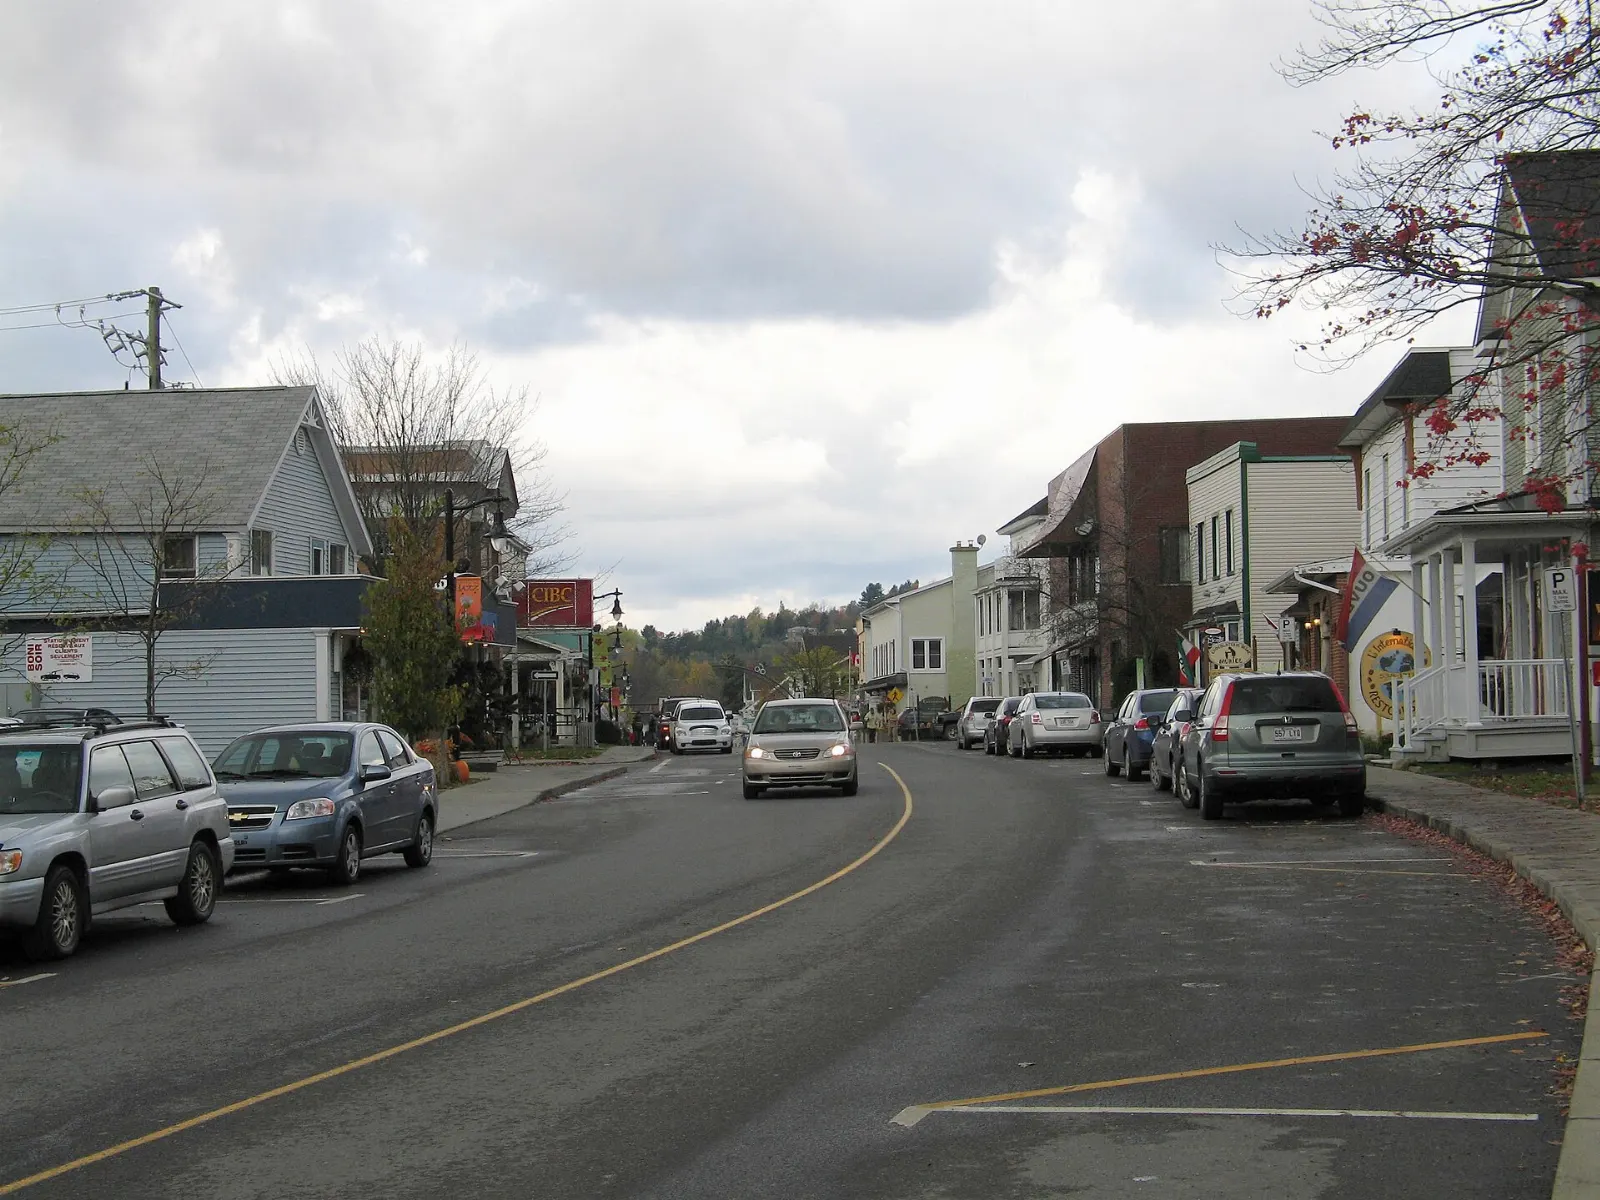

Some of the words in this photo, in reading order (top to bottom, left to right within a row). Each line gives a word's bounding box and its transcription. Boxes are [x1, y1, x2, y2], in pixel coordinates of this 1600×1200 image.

[1552, 573, 1565, 588] P
[532, 587, 572, 603] CIBC
[1283, 619, 1290, 628] P
